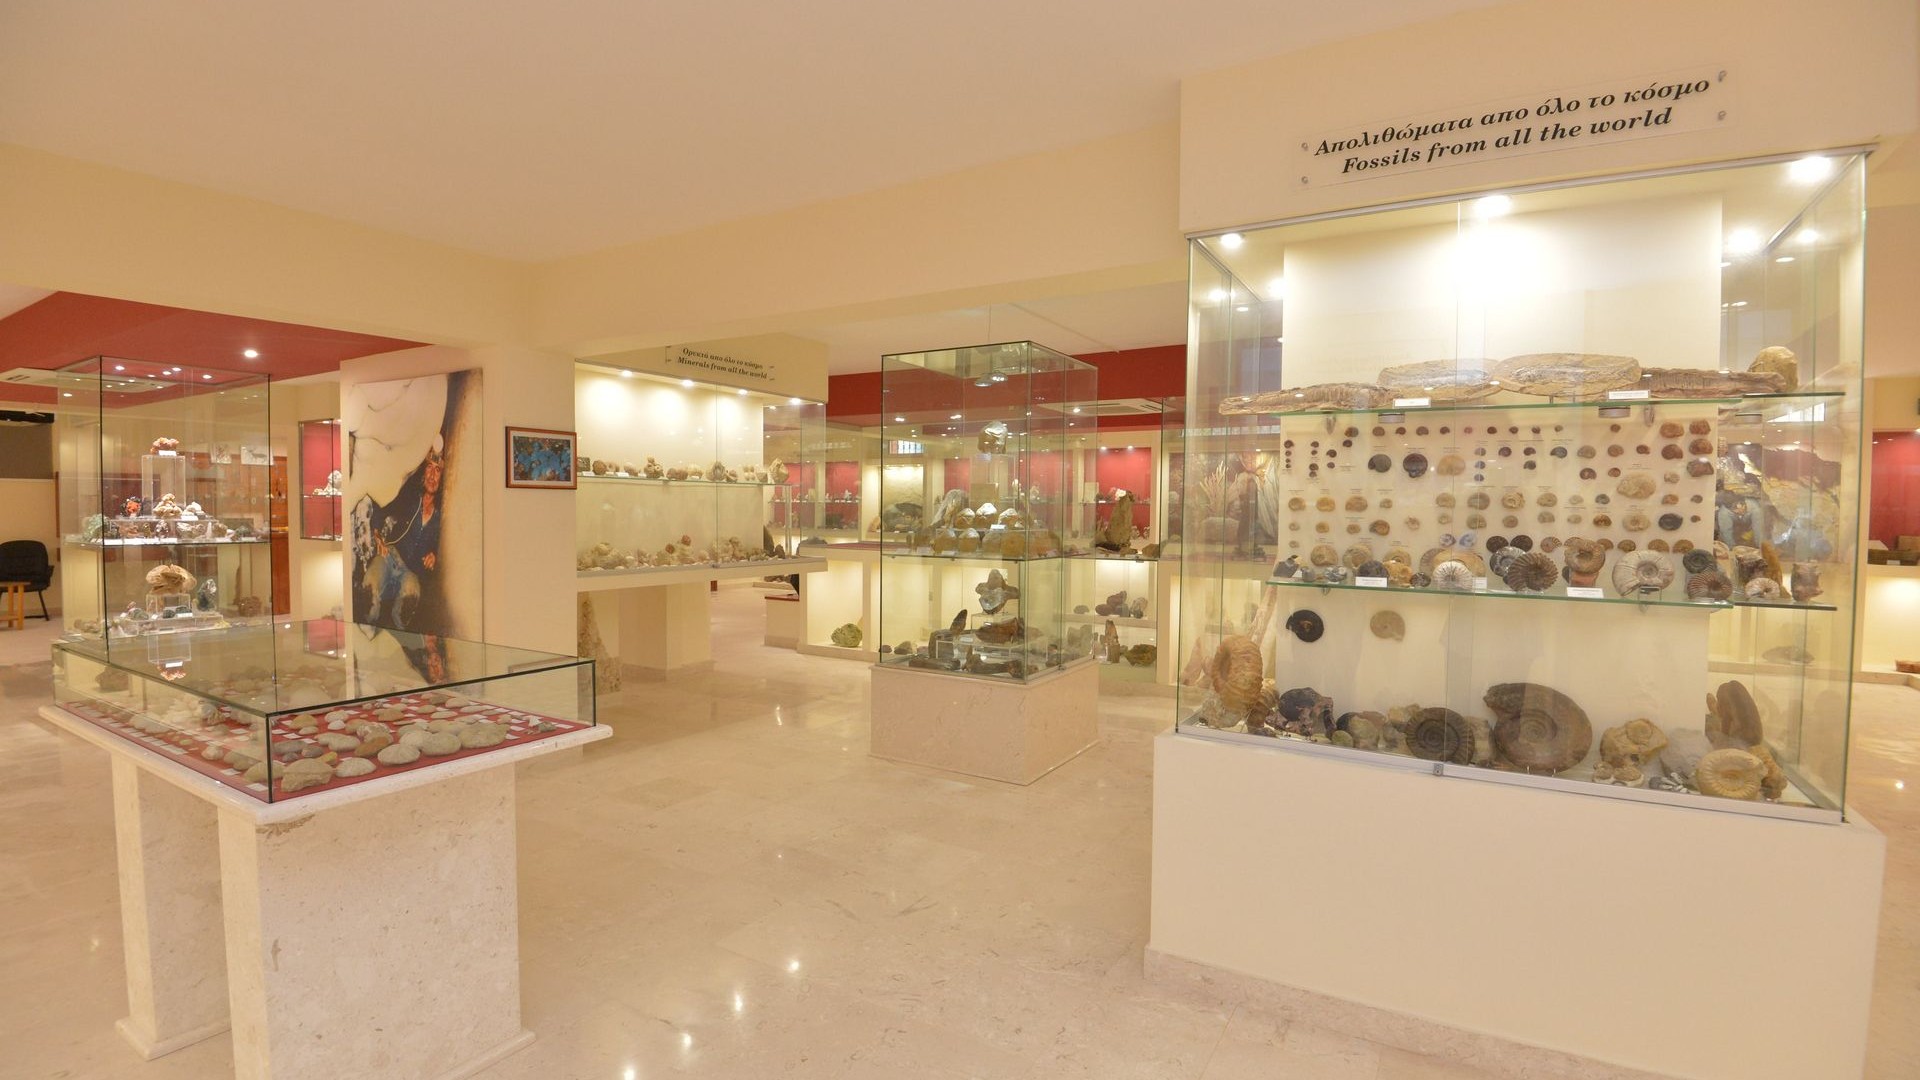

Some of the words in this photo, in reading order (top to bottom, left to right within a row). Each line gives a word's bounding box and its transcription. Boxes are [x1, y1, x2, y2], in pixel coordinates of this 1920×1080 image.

[1314, 117, 1473, 156] Απολιθώματα
[1480, 107, 1529, 125] απο
[1536, 97, 1580, 117] όλο
[1588, 93, 1615, 109] το
[1623, 79, 1710, 104] κόσμο
[1341, 147, 1420, 173] Fossils
[1427, 138, 1486, 163] from
[1495, 127, 1532, 148] all
[1540, 123, 1582, 142] the
[1590, 107, 1673, 135] world
[678, 357, 710, 368] Minerals
[711, 363, 727, 372] from
[739, 367, 748, 375] the
[749, 370, 768, 379] world
